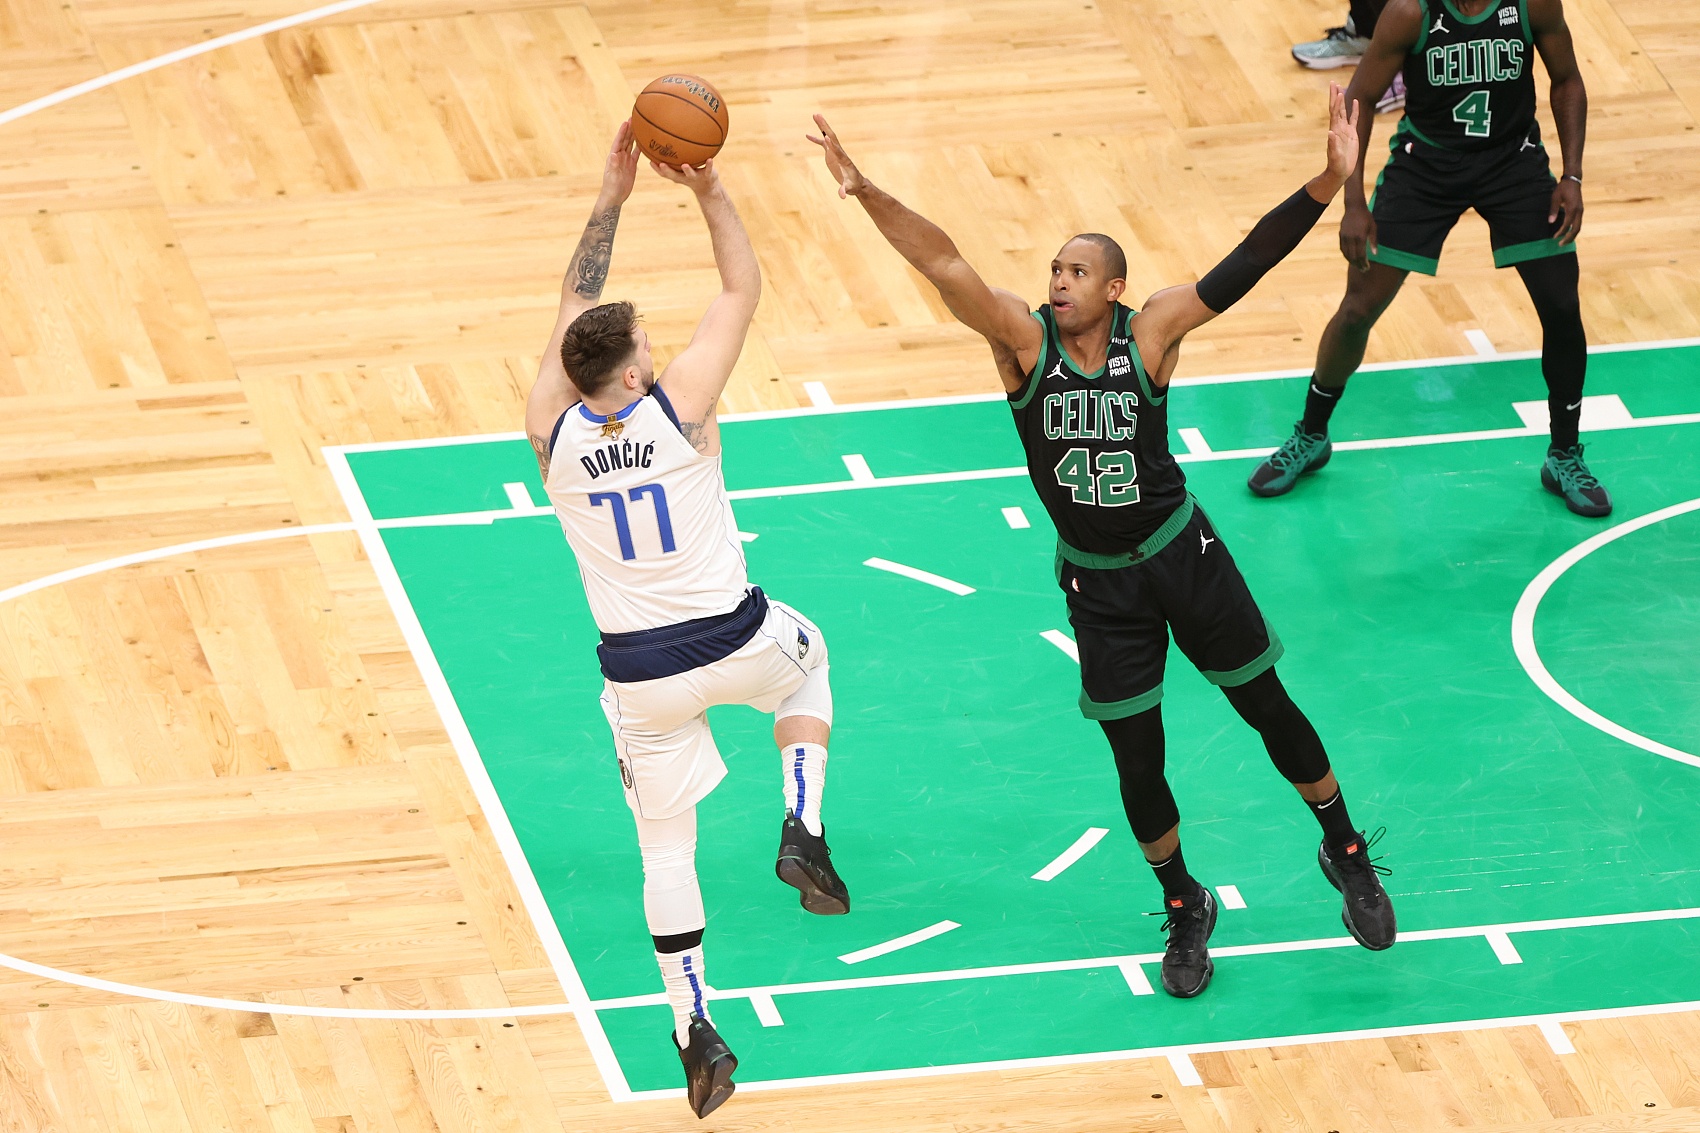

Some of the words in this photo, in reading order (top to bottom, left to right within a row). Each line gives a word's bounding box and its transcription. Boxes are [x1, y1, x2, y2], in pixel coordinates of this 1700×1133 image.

[1498, 6, 1518, 19] VISTA
[1499, 16, 1519, 26] PRINT
[1426, 39, 1524, 86] CELTICS
[1452, 90, 1492, 137] 4
[1107, 355, 1131, 369] VISTA
[1109, 365, 1132, 377] PRINT
[1043, 389, 1139, 441] CELTCS
[579, 438, 656, 480] DONČIĆ
[1054, 448, 1140, 507] 42
[588, 483, 677, 561] 77
